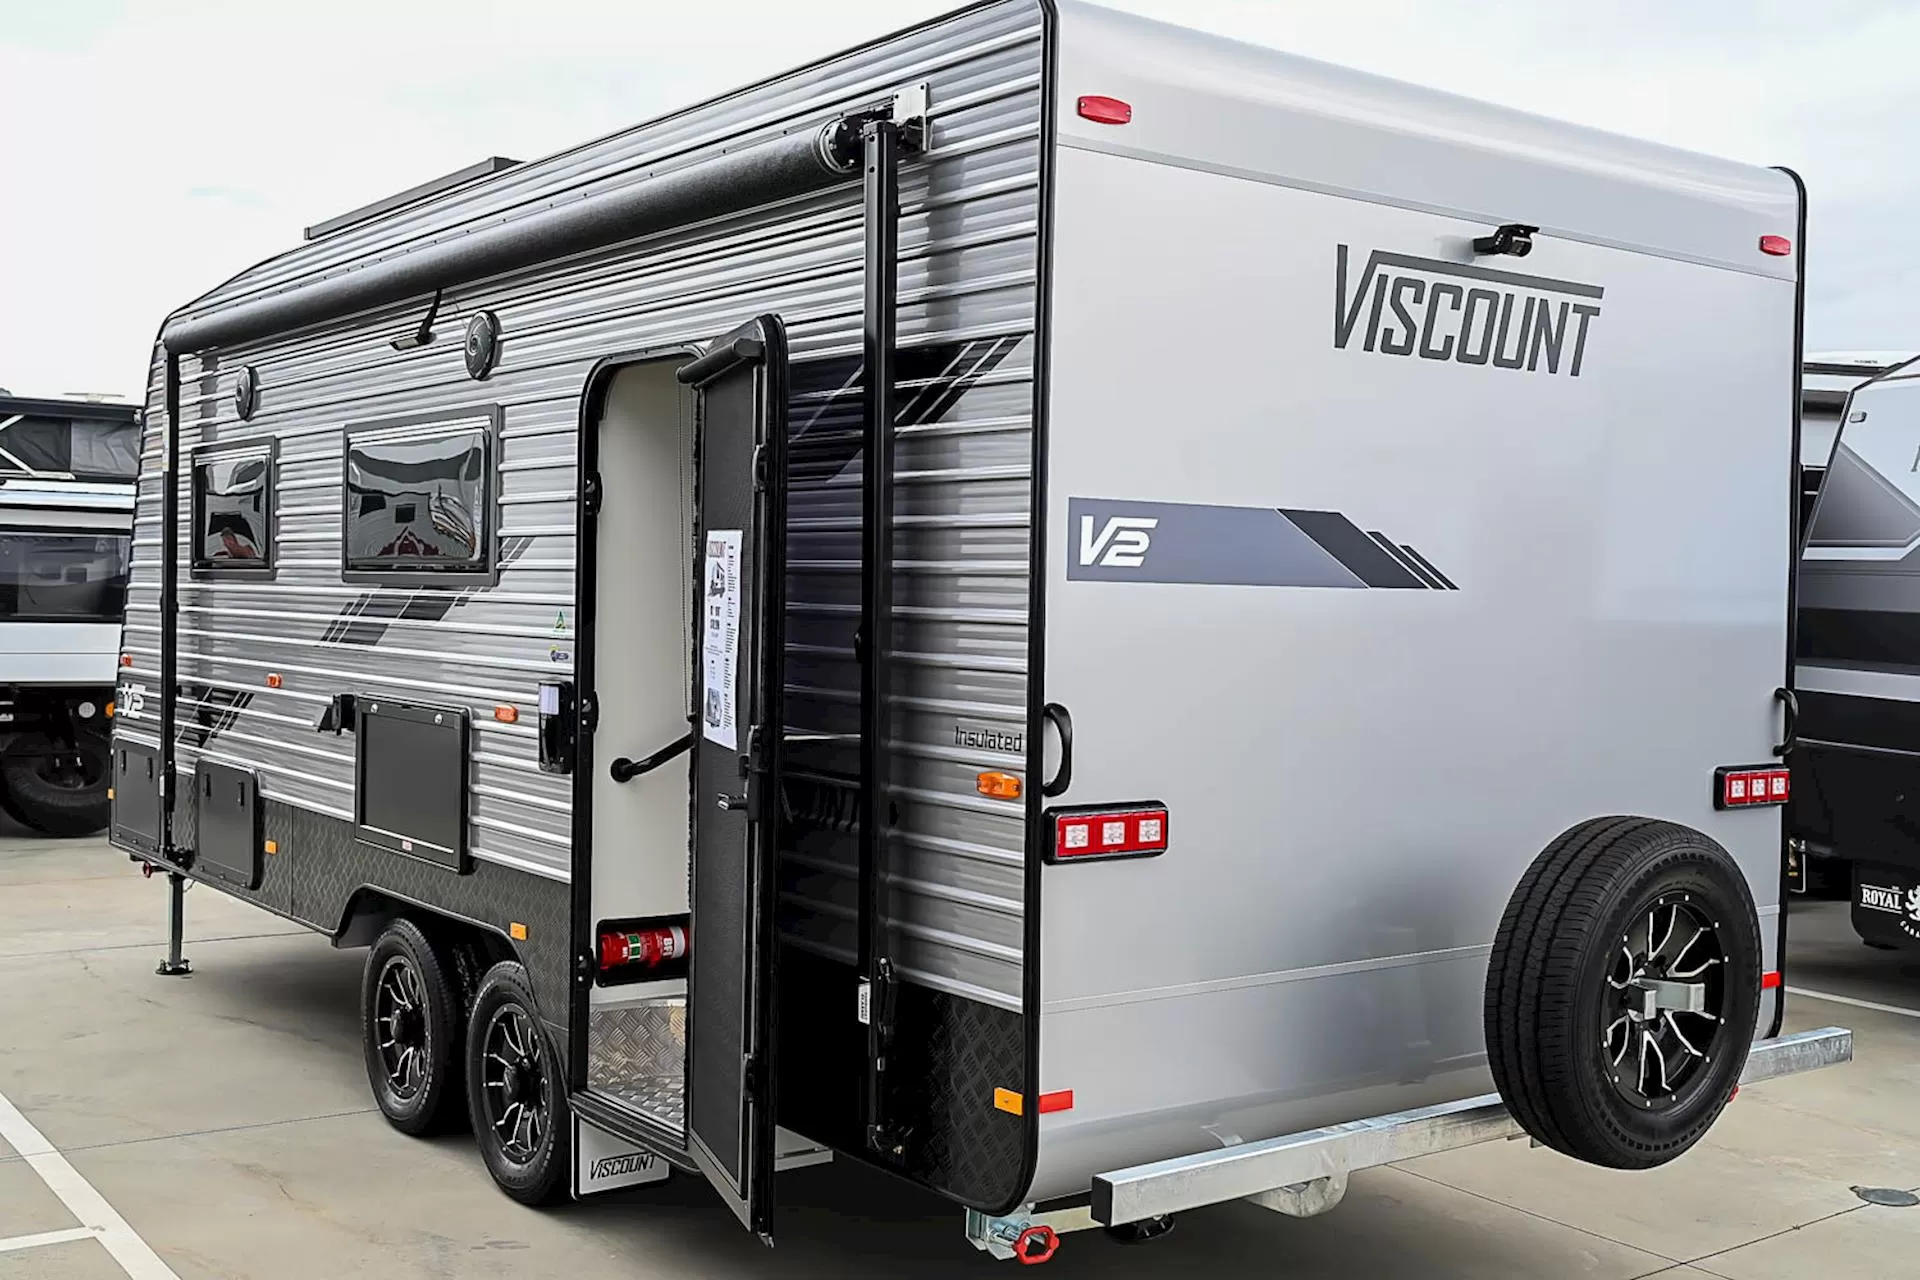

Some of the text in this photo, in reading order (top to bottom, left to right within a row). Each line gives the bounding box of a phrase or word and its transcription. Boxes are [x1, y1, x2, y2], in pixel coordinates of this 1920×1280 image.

[1334, 244, 1604, 377] VISCOUNT
[1080, 515, 1159, 567] V2
[955, 726, 1022, 752] Insulated
[1862, 887, 1902, 910] ROYAL
[590, 1151, 655, 1180] VISCOUNT
